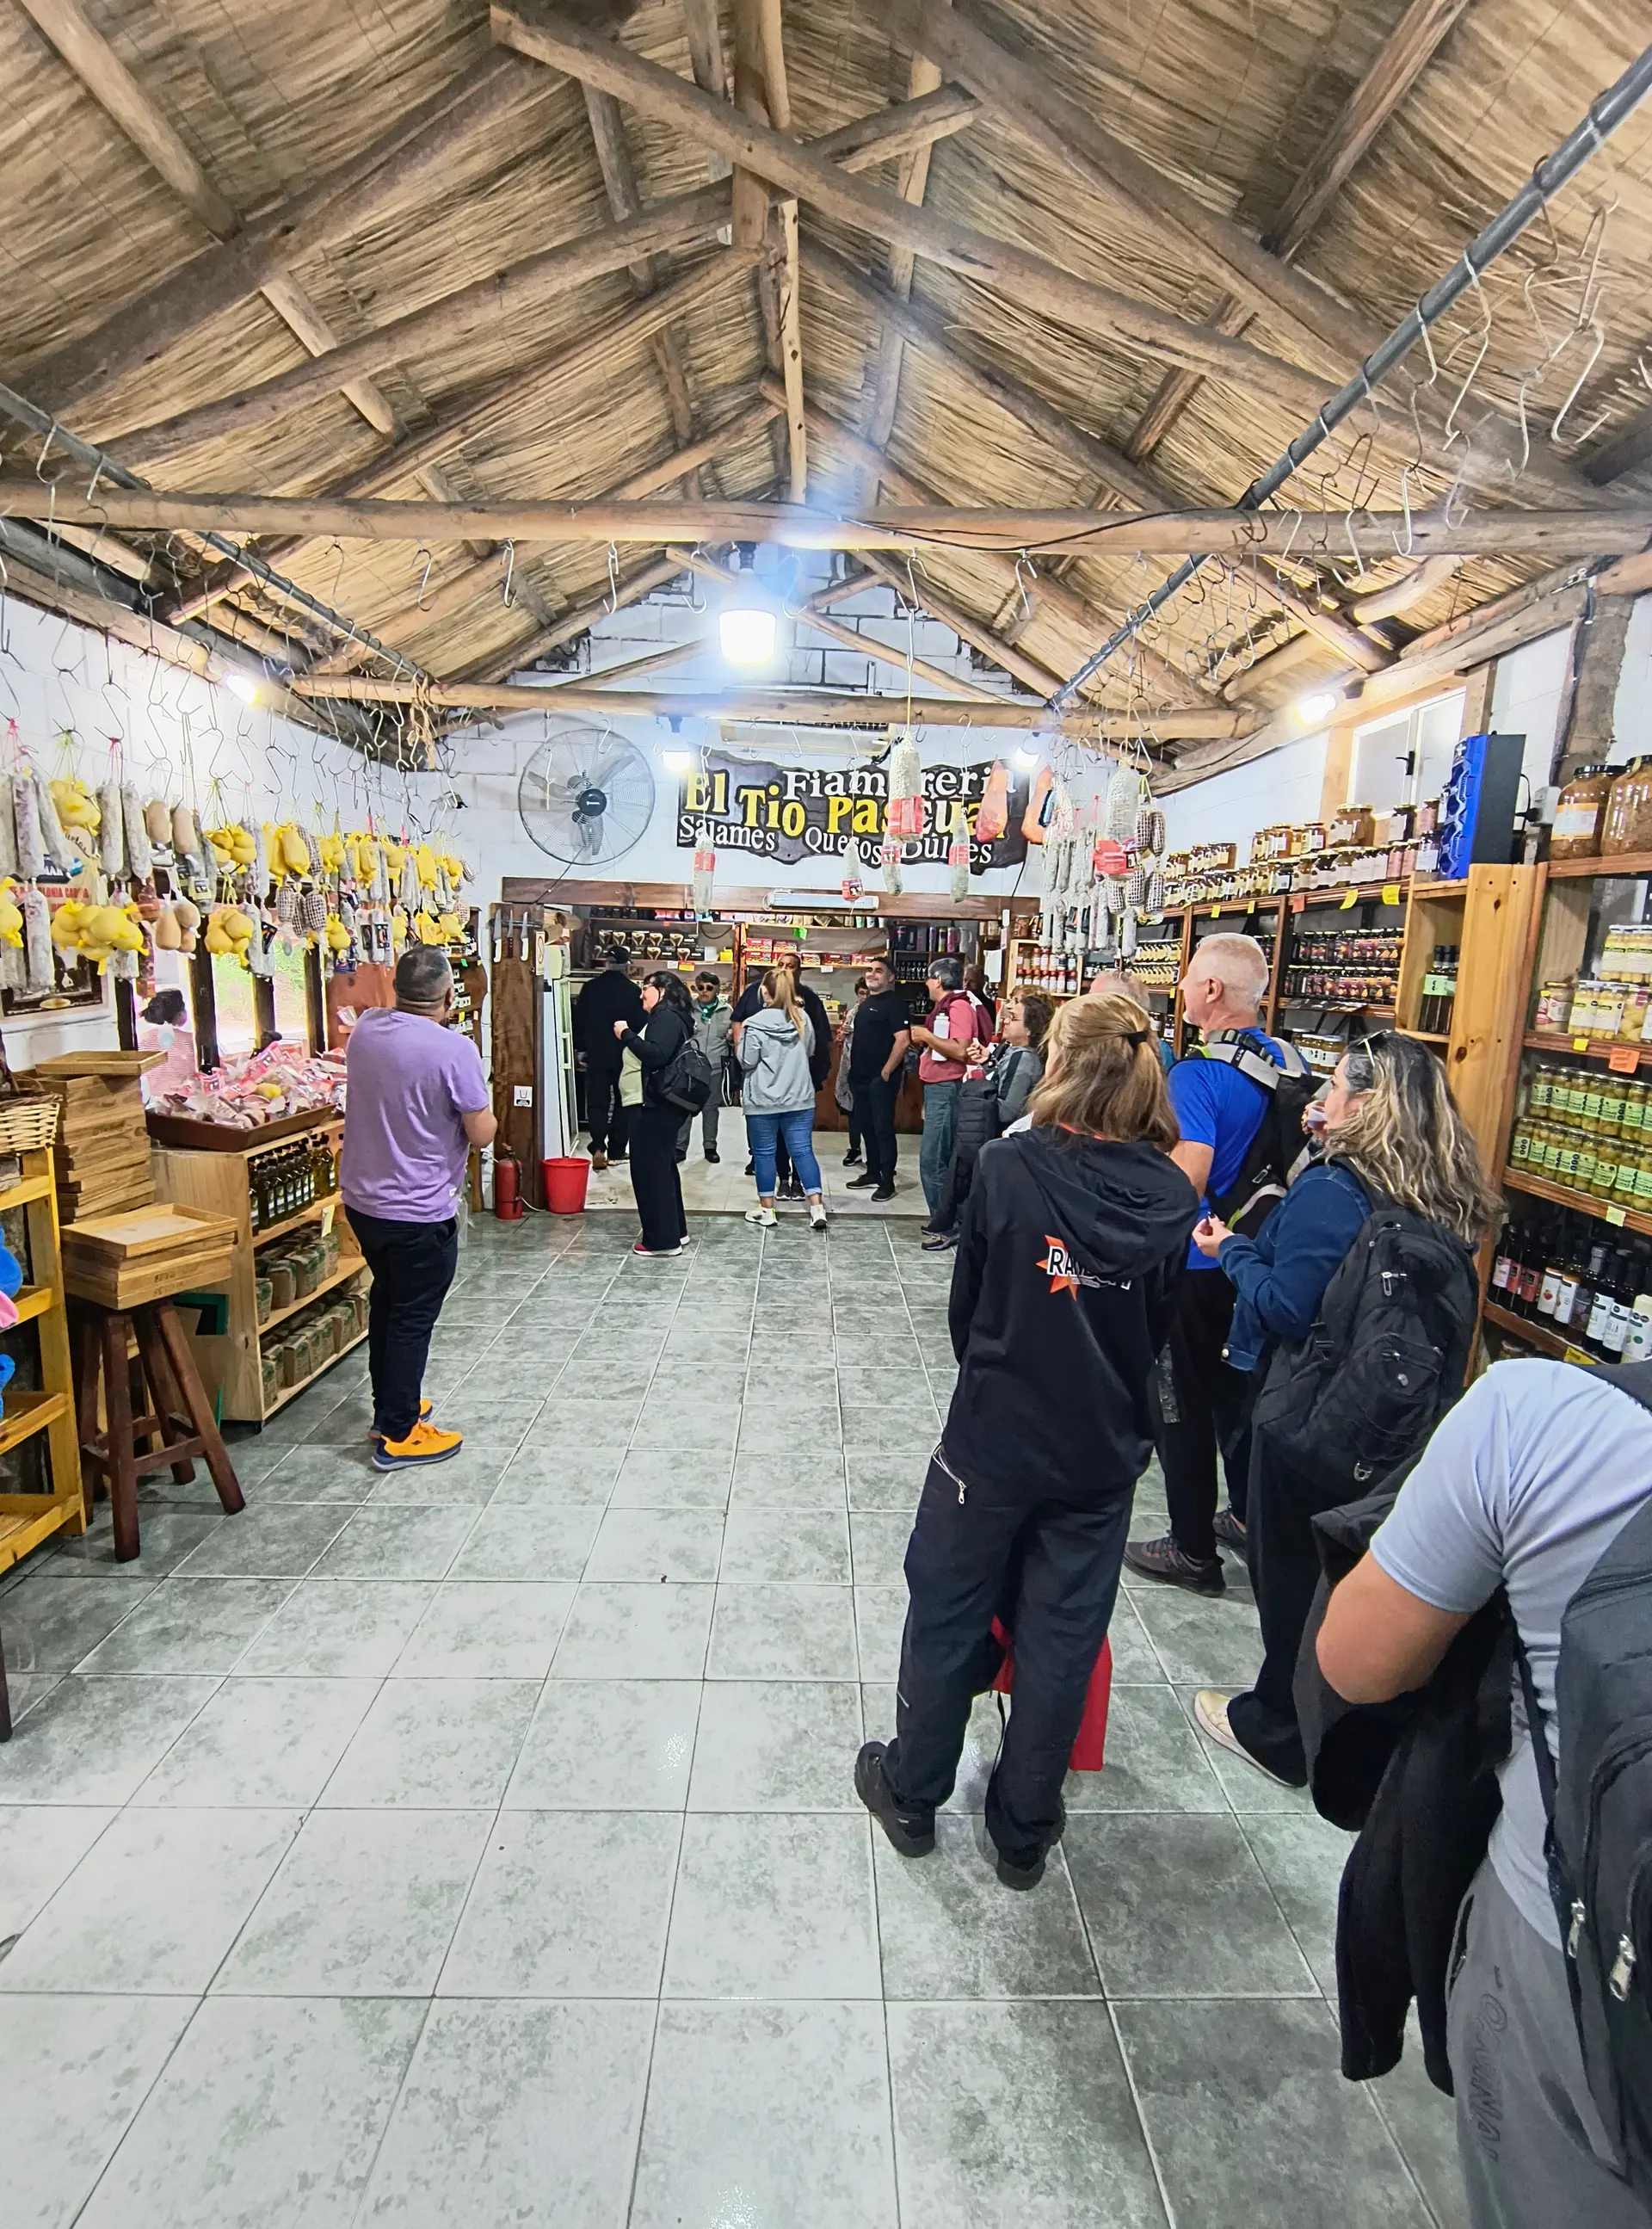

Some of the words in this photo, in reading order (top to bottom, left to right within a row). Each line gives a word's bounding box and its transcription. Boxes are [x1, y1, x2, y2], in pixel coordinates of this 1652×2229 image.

[685, 773, 727, 813] El
[739, 785, 805, 837] Tio
[680, 815, 775, 851] Salames
[804, 827, 882, 865] Queos
